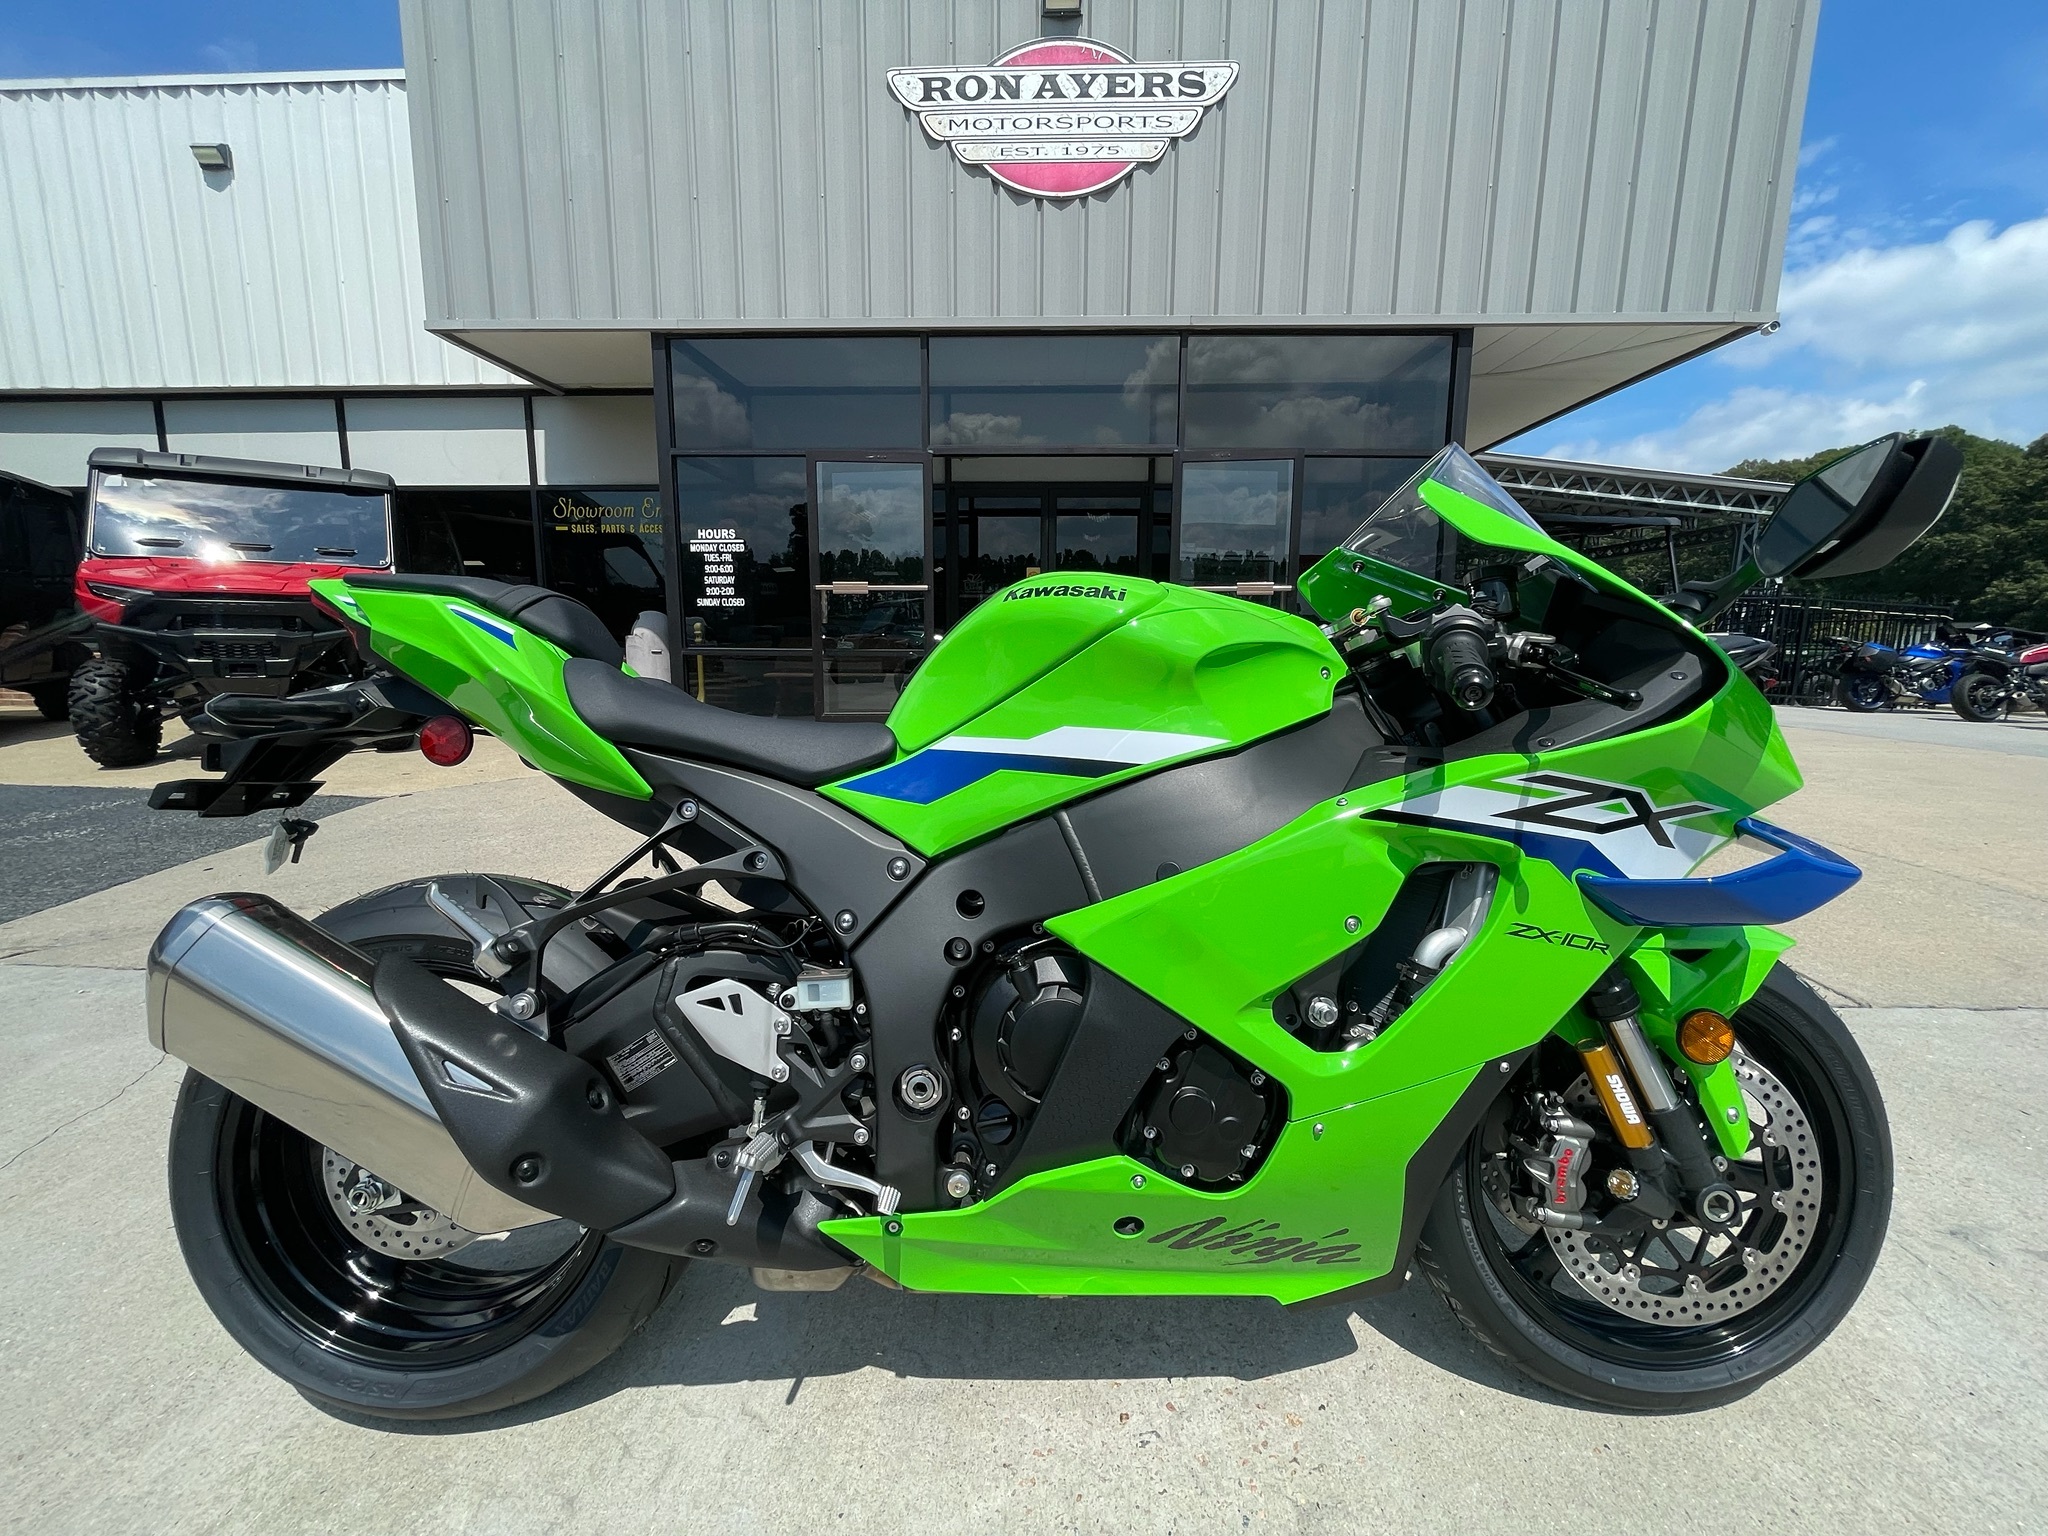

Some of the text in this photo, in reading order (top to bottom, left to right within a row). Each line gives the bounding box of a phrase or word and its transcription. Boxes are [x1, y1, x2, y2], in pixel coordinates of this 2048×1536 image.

[918, 69, 1208, 102] RON AYERS
[948, 114, 1174, 132] MOTORSPORTS
[999, 145, 1121, 157] EST. 1975
[553, 497, 635, 520] Showroom
[571, 524, 598, 534] SALES,
[601, 524, 626, 533] PARTS
[629, 524, 635, 533] &
[697, 528, 736, 539] HOURS
[690, 543, 745, 552] MONDAY CLOSED
[704, 564, 734, 573] 9:00-6:00
[703, 575, 736, 584] SATURDAY
[705, 586, 735, 595] 9:00-2:00
[1003, 585, 1128, 602] Kawasaki
[696, 597, 746, 606] SUNDAY CLOSED
[1489, 773, 1715, 850] ZX
[1505, 922, 1610, 956] ZX-10R
[1605, 1074, 1641, 1125] SHOWA
[1554, 1148, 1574, 1204] brembo
[1147, 1216, 1362, 1267] Ninja
